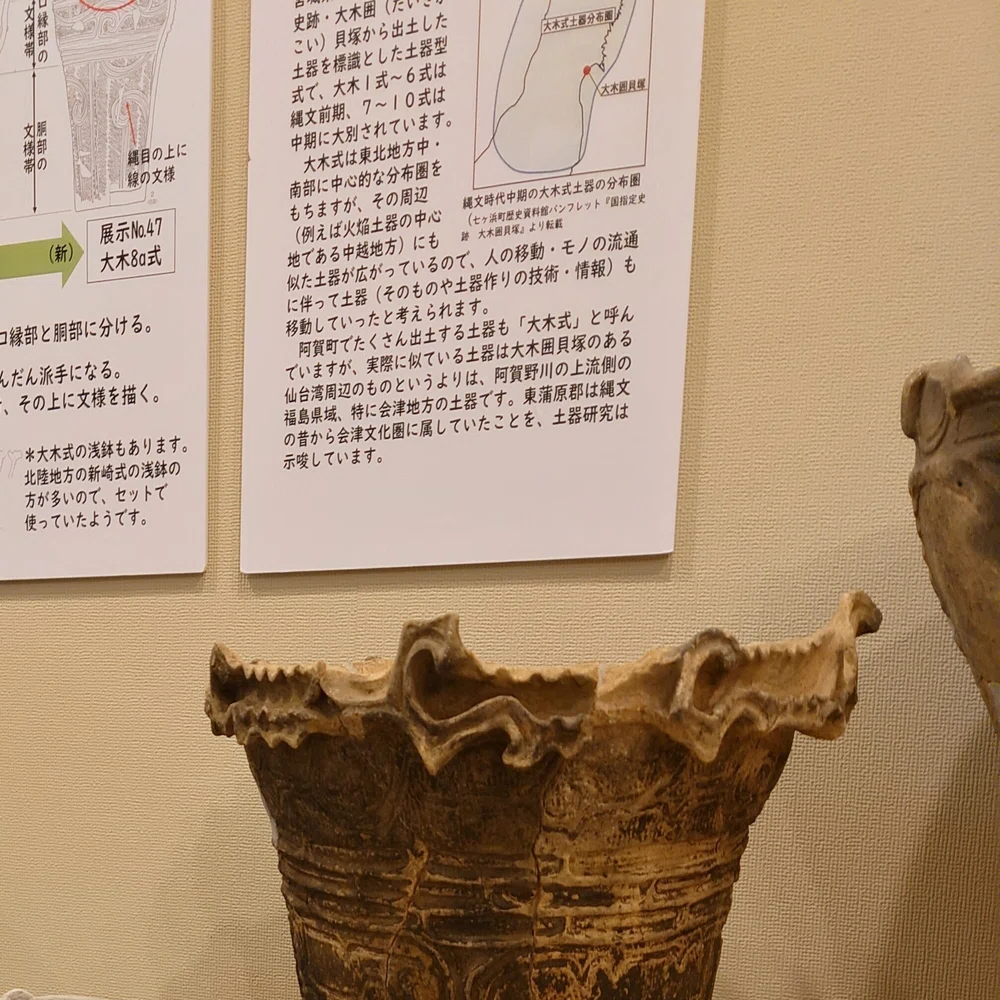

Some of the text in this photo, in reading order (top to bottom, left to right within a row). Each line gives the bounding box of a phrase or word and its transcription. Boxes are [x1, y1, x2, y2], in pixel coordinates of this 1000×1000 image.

[543, 9, 614, 32] 大木式土器分布圏
[292, 36, 448, 79] 土器を標識とした土器型
[601, 78, 646, 96] 大木囲貝塚
[36, 121, 48, 171] 胴部の
[290, 110, 453, 150] 中期に大別されています。
[23, 124, 35, 174] 文様帯
[127, 143, 187, 166] 縄目の上に
[303, 138, 441, 173] 大木式は東北地方中・
[127, 167, 176, 188] 線の文様
[289, 161, 442, 199] 南部に中心的な分布圏を
[462, 173, 641, 210] 縄文時代中期の大木式土器の分布圏
[289, 187, 428, 221] もちますが、その周辺
[100, 248, 162, 273] 大木8a式
[287, 230, 440, 268] 地である中越地方）にも
[287, 230, 640, 292] 似た土器が広がっているので、人の移動・モノの流通
[286, 299, 489, 338] 移動していったと考えられます。
[285, 330, 632, 381] でいますが、実際に似ている土器は大木囲貝塚のある
[285, 355, 631, 404] 仙台湾周辺のものというよりは、阿賀野川の上流側の
[284, 379, 630, 427] 福島県域、特に会津地方の土器です。東蒲原郡は縄文
[283, 404, 629, 447] の昔から会津文化圏に属していたことを、土器研究は
[24, 460, 181, 486] 北陸地方の新崎式の浅鉢の
[283, 446, 383, 470] 示唆しています。
[25, 483, 168, 509] 方が多いので、セットで
[25, 508, 148, 532] 使っていたようです。
